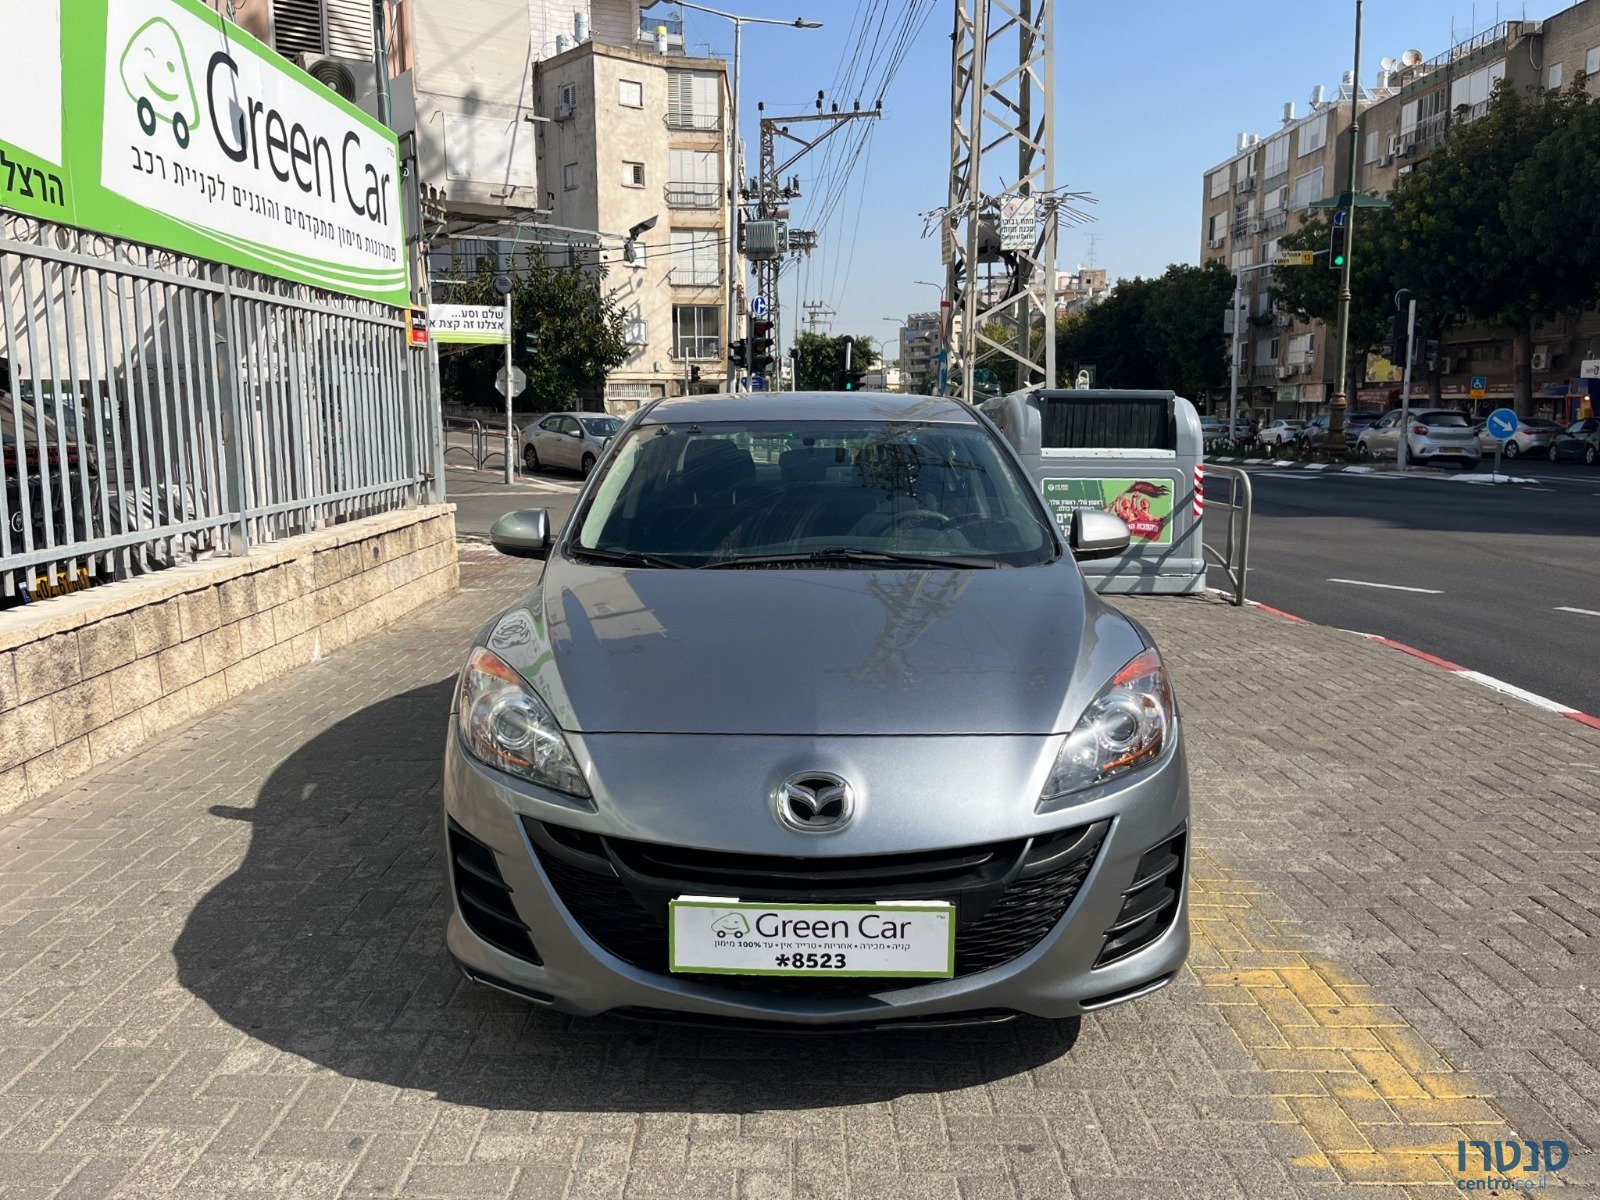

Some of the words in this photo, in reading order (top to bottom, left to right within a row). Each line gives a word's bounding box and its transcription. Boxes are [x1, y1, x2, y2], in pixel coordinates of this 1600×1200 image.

[207, 51, 336, 203] Green
[342, 131, 389, 226] Car
[131, 145, 166, 180] רכב
[173, 161, 225, 203] לקניית
[232, 185, 280, 221] והוגנים
[285, 205, 335, 239] מתקדמים
[338, 226, 362, 249] מימון
[365, 237, 396, 262] פתרונות
[1303, 254, 1311, 262] 13
[481, 309, 504, 319] שלם
[439, 319, 460, 330] קצת
[463, 320, 475, 329] זה
[477, 320, 505, 330] אצלנו
[755, 912, 849, 938] Green
[858, 914, 912, 939] Car
[714, 940, 736, 948] מימון
[762, 941, 773, 949] עד
[780, 942, 792, 950] אין
[859, 942, 885, 950] מכירה
[891, 943, 911, 951] קניה
